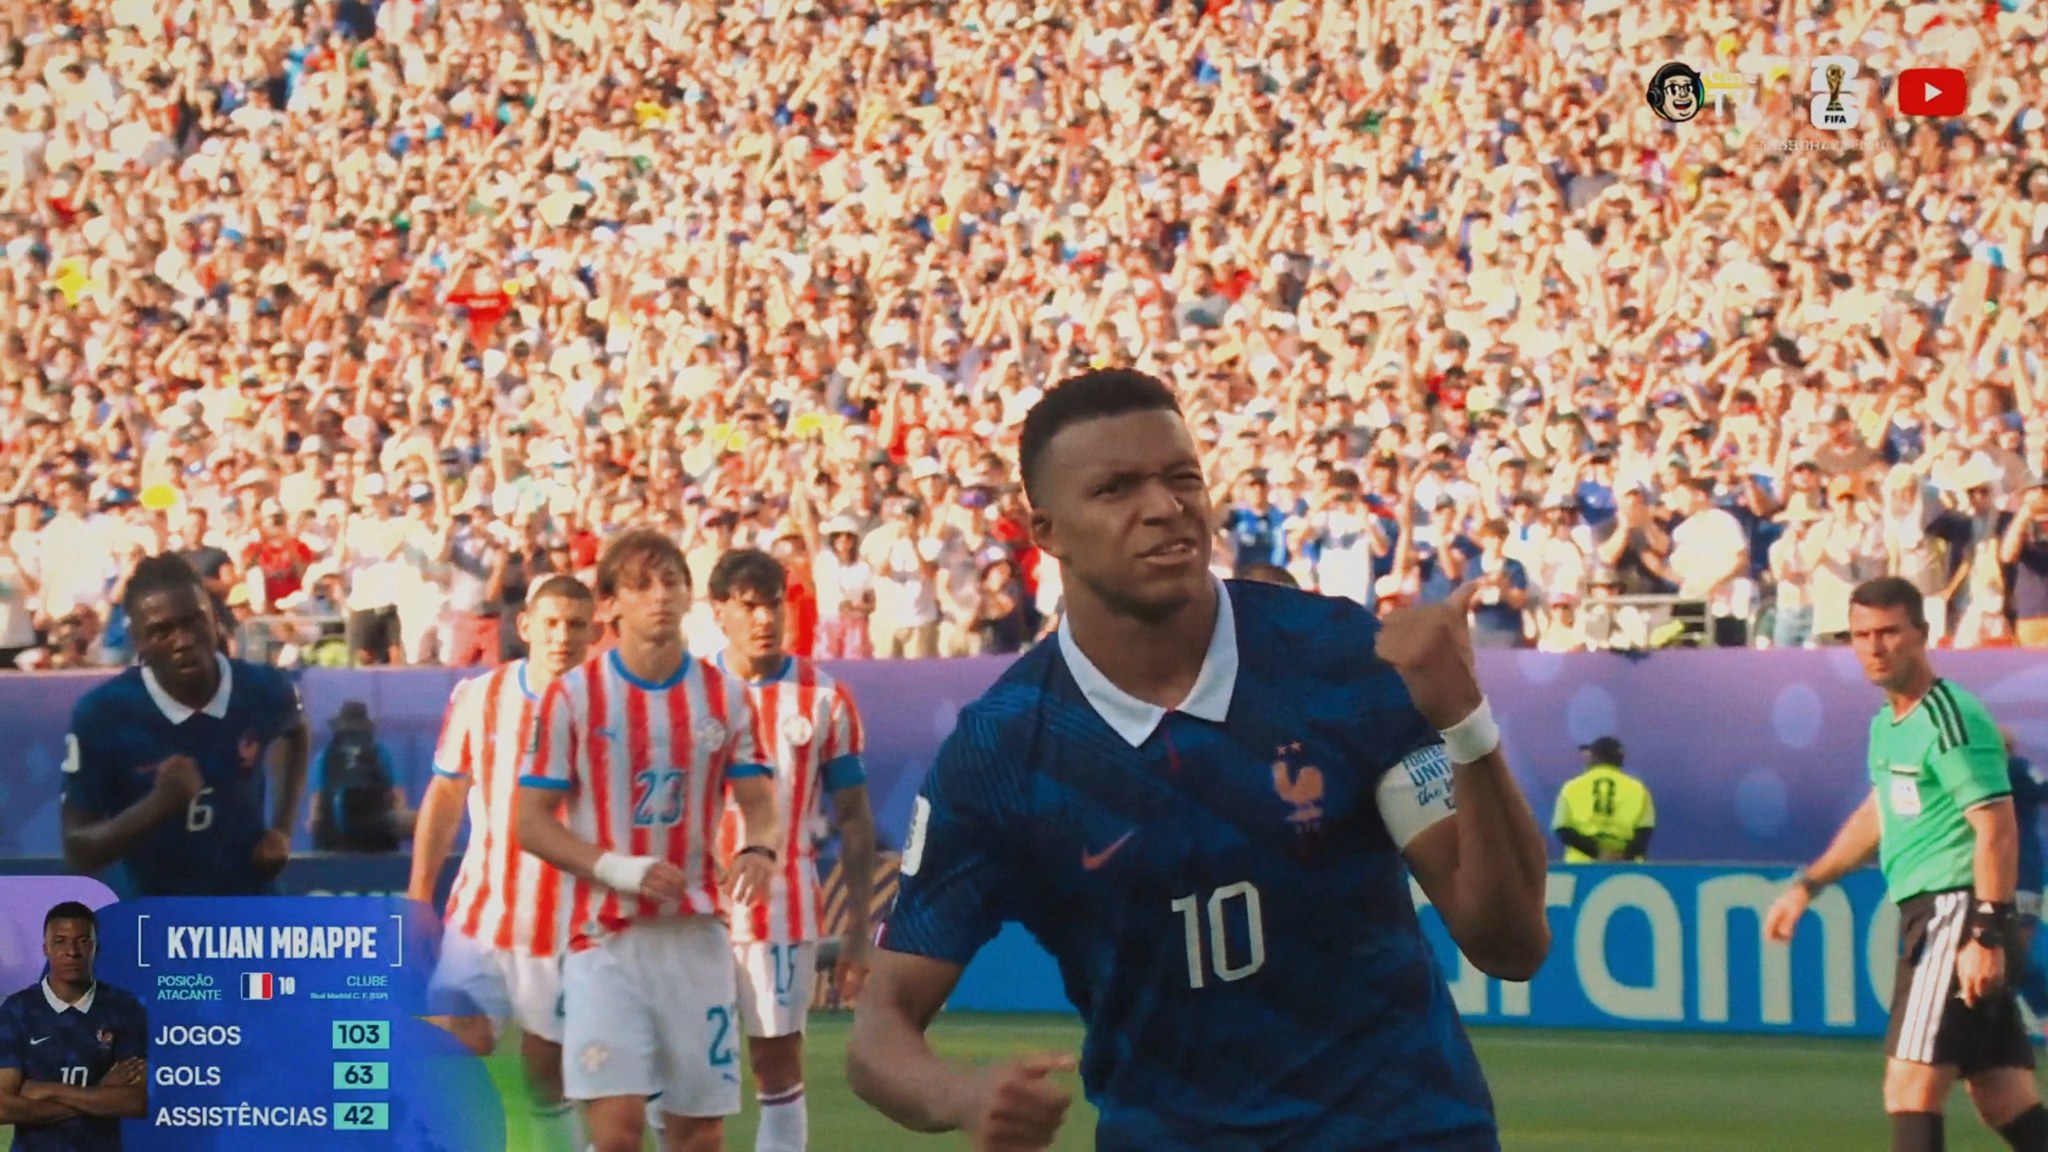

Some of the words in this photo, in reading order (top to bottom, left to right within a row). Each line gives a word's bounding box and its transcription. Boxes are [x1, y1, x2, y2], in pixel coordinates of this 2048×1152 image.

[633, 769, 685, 825] 23
[1409, 758, 1452, 787] UNIT
[186, 787, 213, 832] 6
[1171, 881, 1265, 988] 10
[706, 1005, 739, 1067] 2
